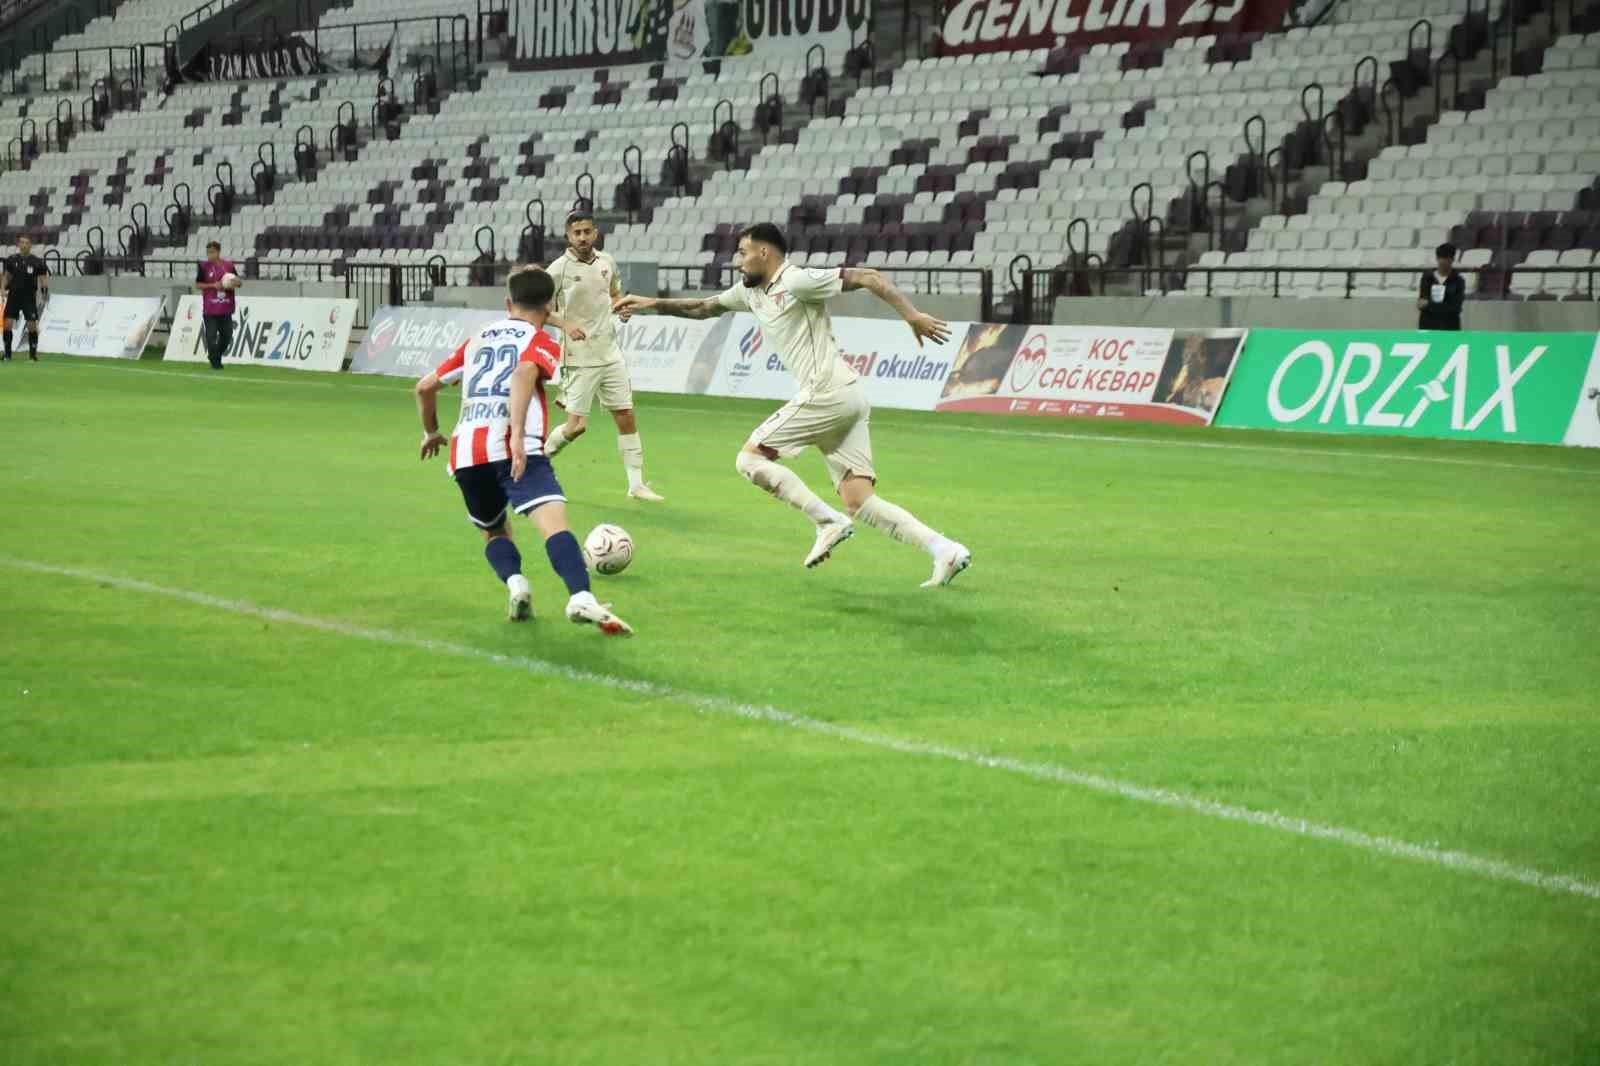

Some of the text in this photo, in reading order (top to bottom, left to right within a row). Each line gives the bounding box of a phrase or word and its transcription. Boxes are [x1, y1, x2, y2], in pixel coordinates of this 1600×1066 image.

[467, 344, 518, 398] 22
[876, 354, 949, 381] okulları
[1087, 338, 1136, 366] KOÇ
[1267, 340, 1549, 433] ORZAX
